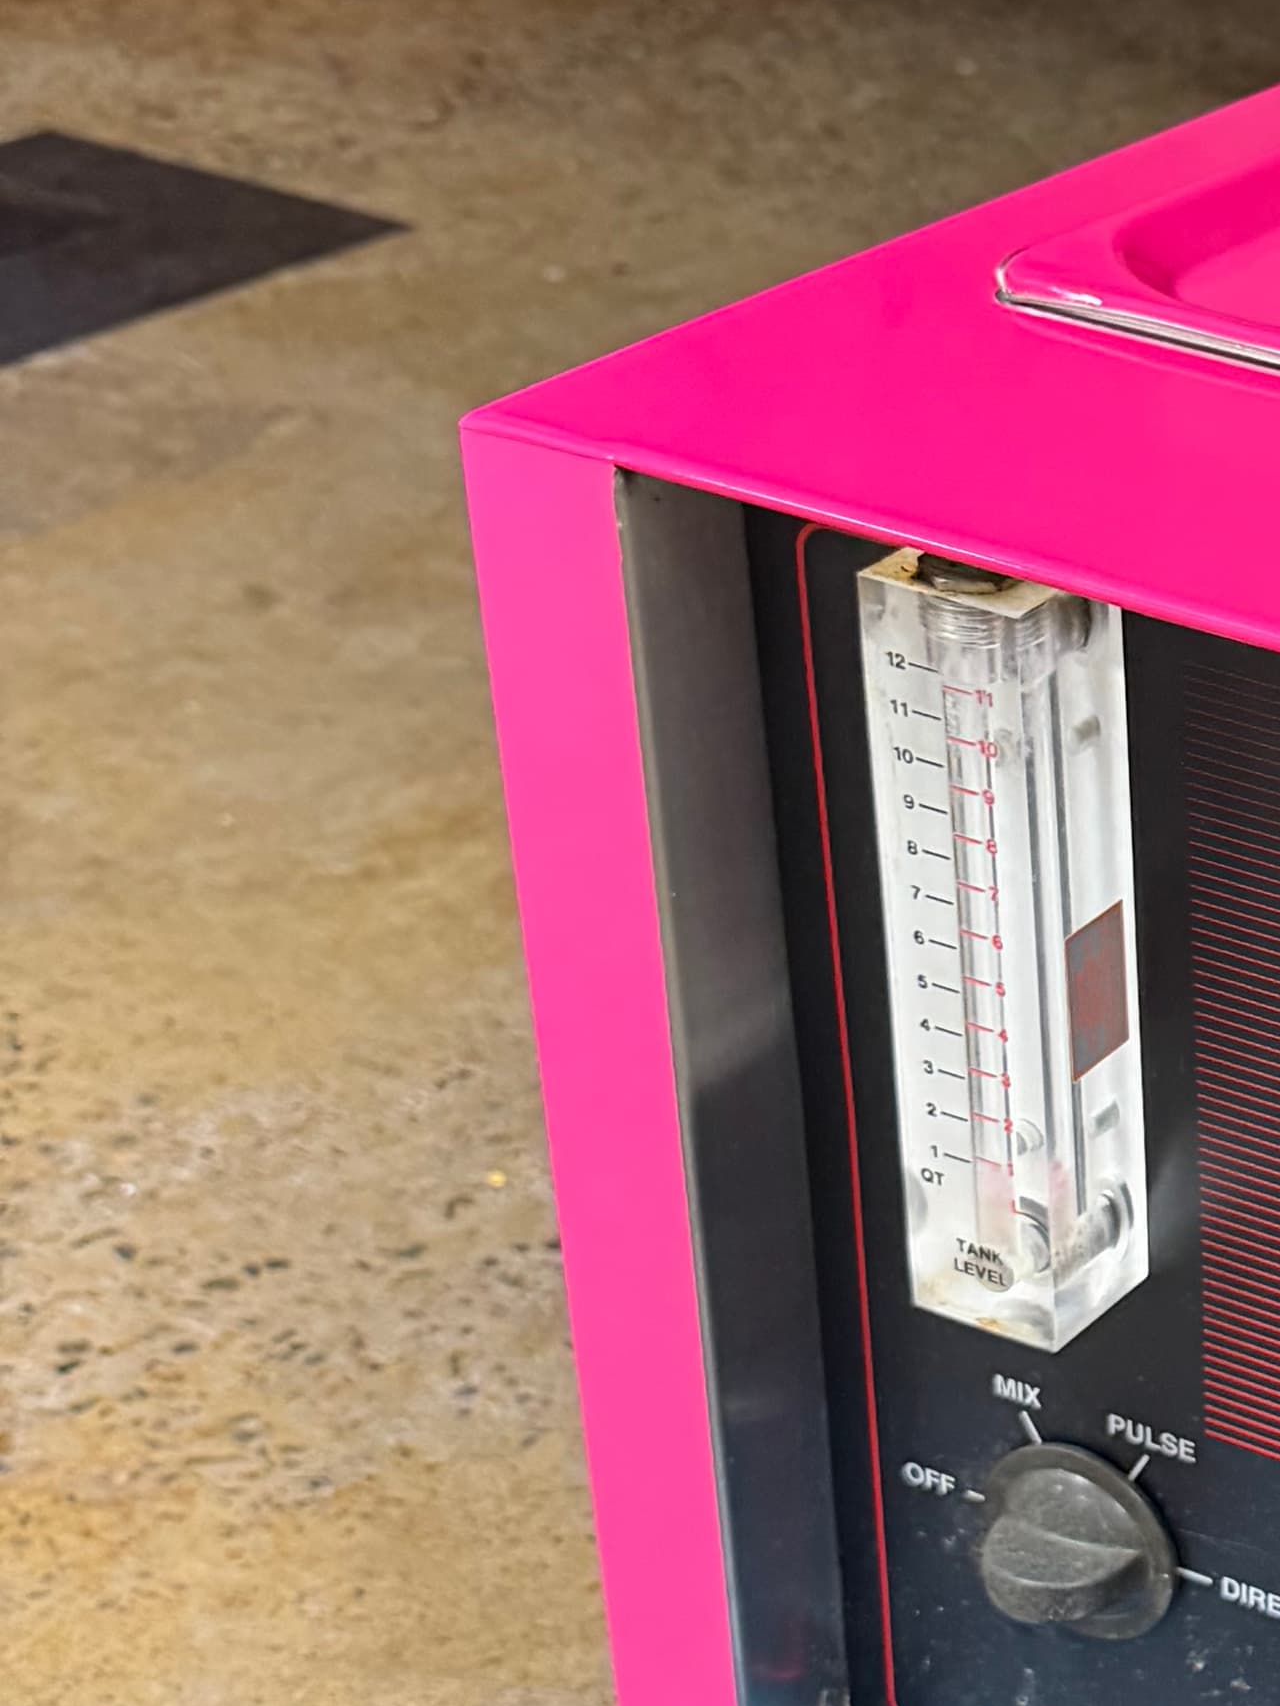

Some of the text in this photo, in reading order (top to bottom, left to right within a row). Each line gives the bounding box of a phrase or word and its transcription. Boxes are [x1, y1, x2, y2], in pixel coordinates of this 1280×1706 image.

[886, 651, 905, 670] 12
[890, 698, 908, 717] 11
[894, 746, 913, 764] 10
[904, 794, 914, 809] 9
[907, 840, 918, 855] 8
[912, 885, 921, 900] 7
[914, 930, 925, 945] 6
[918, 975, 928, 989] 5
[920, 1018, 930, 1032] 4
[924, 1061, 934, 1074] 3
[927, 1102, 937, 1117] 2
[931, 1145, 938, 1158] 1
[920, 1167, 945, 1185] QT
[956, 1237, 1004, 1266] TANK
[953, 1257, 1008, 1287] LEVEL
[992, 1373, 1042, 1409] MIX
[1106, 1413, 1197, 1464] PULSE
[901, 1461, 956, 1495] OFF
